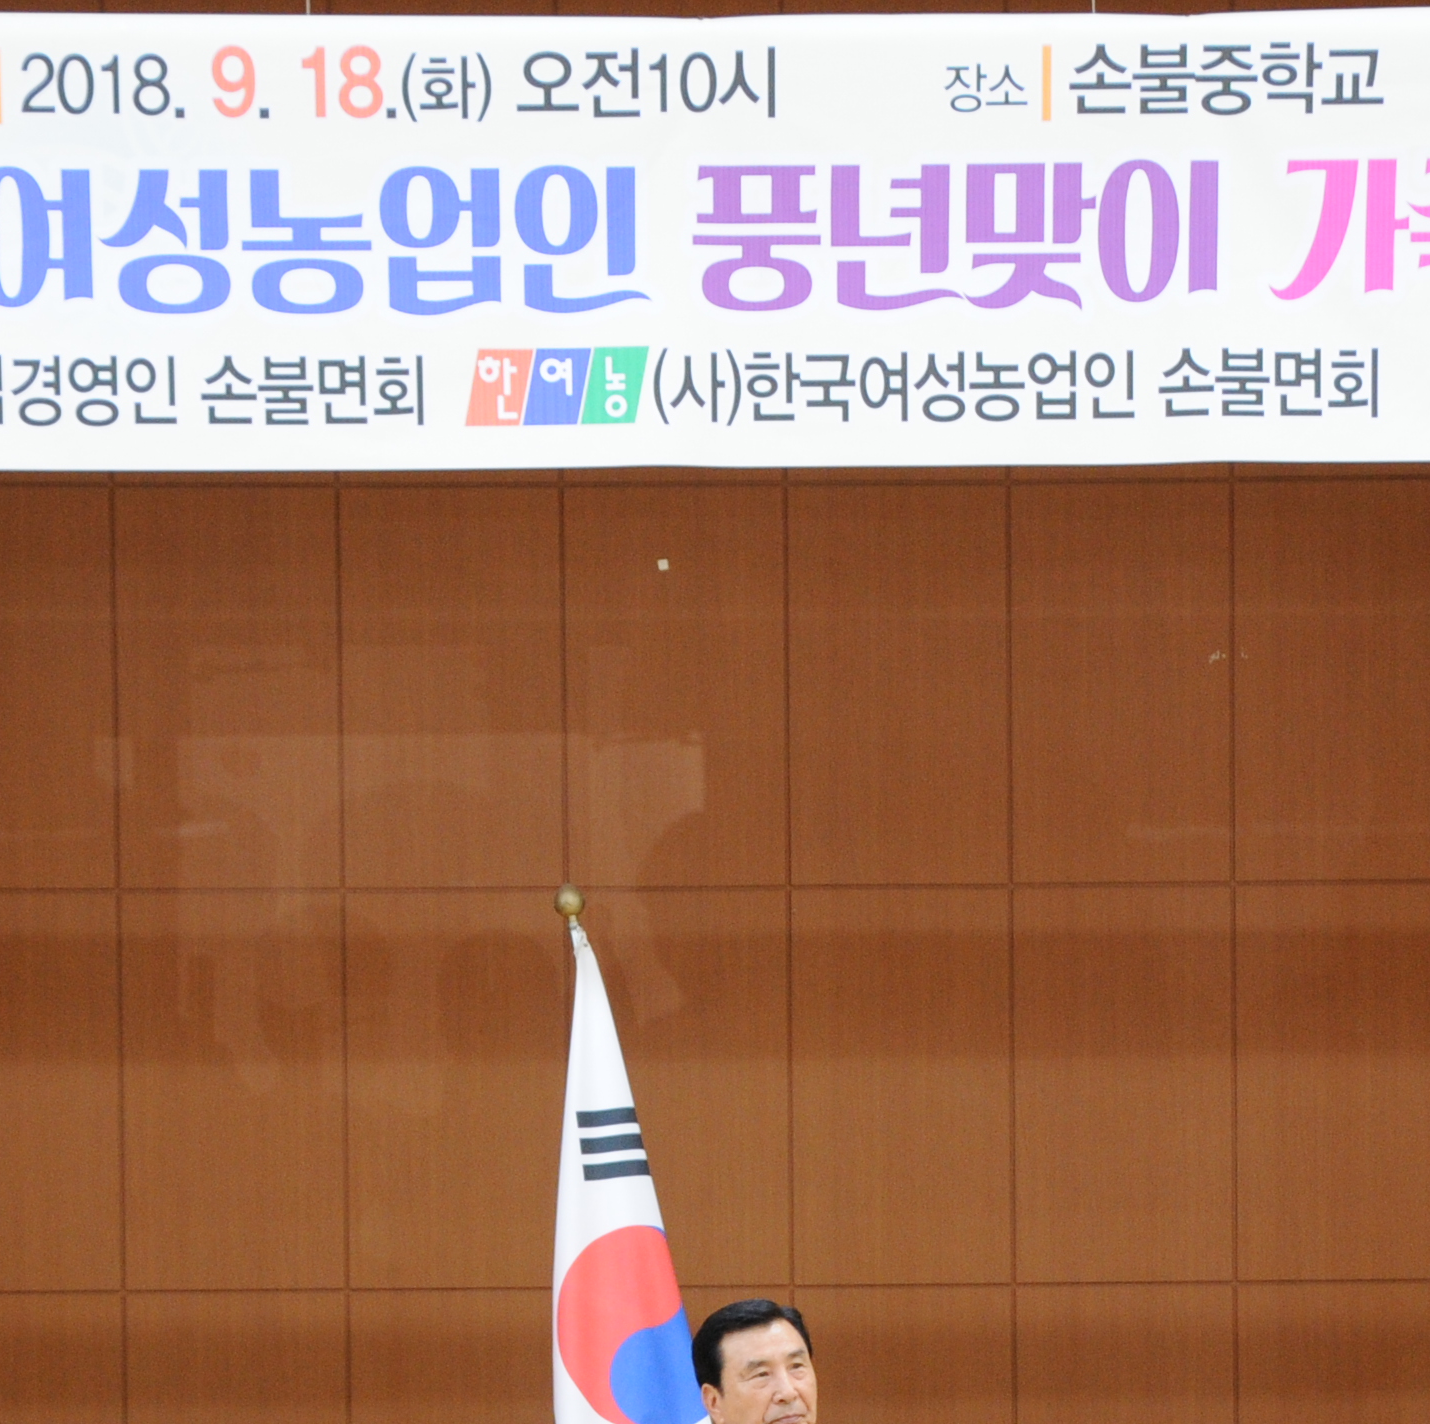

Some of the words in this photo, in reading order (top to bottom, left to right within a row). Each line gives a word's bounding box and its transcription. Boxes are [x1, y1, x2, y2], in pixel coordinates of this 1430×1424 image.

[20, 52, 187, 120] 2018.
[210, 44, 271, 120] 9.
[516, 46, 777, 120] 오전10시
[943, 62, 1029, 114] 장소
[1068, 41, 1385, 117] 손불중학교
[691, 158, 1220, 313] 풍년맞이
[200, 355, 426, 427] 손불면회
[651, 348, 1137, 428] (사)한국여성농업인
[1157, 346, 1381, 420] 손불면회
